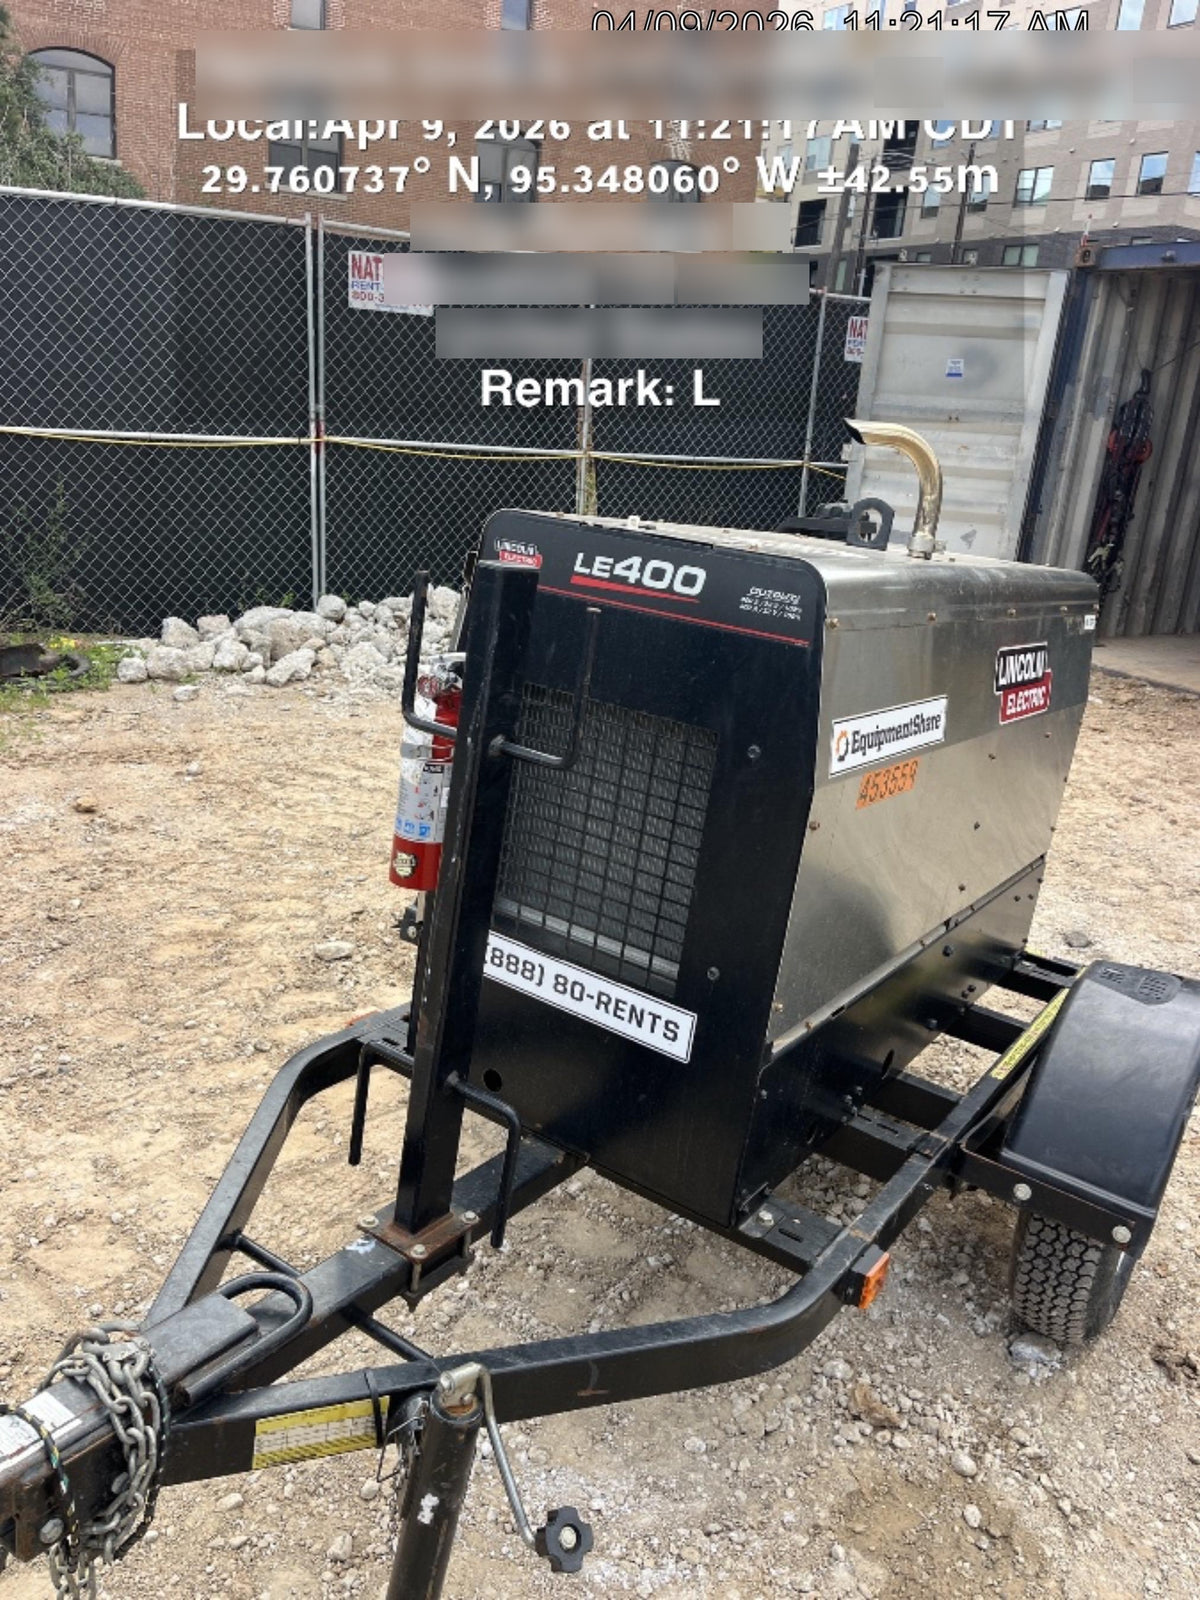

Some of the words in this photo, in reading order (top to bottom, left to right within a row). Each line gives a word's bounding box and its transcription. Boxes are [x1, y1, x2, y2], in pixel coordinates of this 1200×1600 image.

[573, 552, 707, 597] LE400
[998, 650, 1045, 686] LINCOLN
[1005, 685, 1047, 716] ELECTRIC
[851, 713, 942, 757] EquipmentShare
[485, 942, 545, 987] 888)
[552, 973, 681, 1043] 80-RENTS
